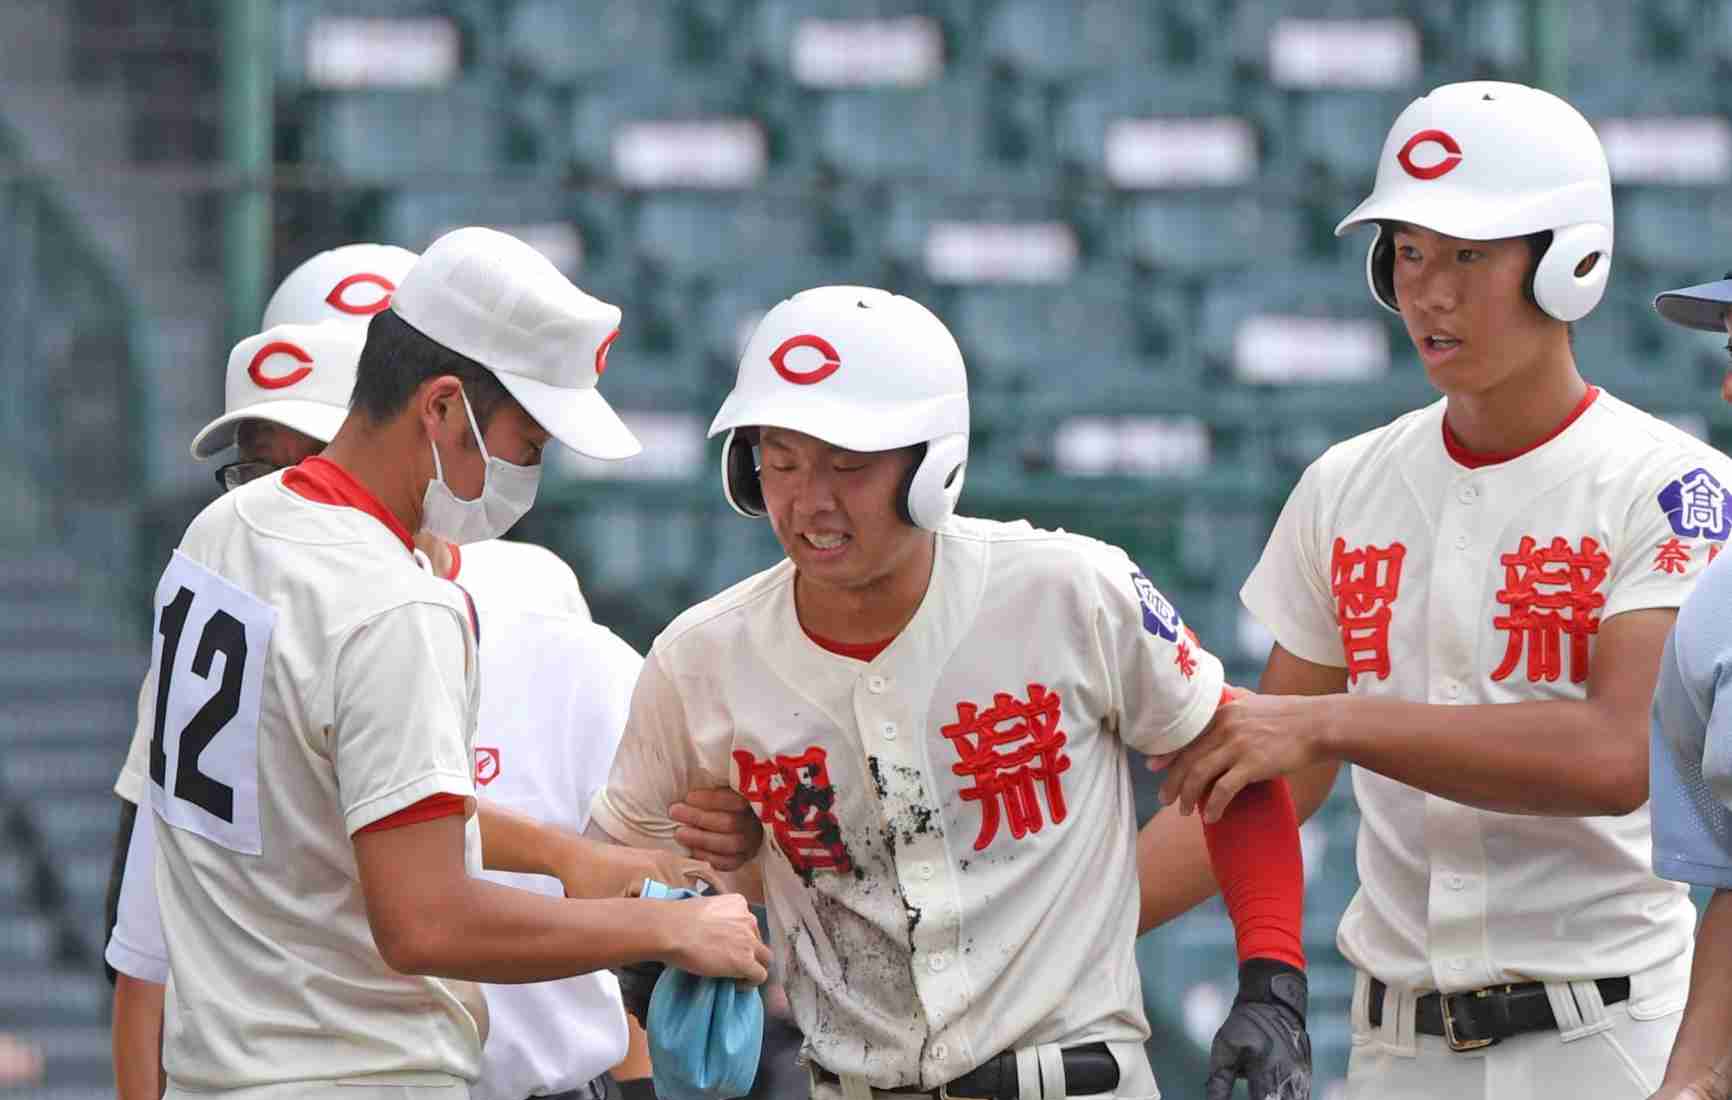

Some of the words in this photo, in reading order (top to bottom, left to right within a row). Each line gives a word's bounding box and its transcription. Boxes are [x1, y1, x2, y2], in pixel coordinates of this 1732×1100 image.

[1397, 129, 1462, 180] C
[248, 342, 314, 390] C
[769, 335, 841, 386] C
[149, 585, 247, 824] 12
